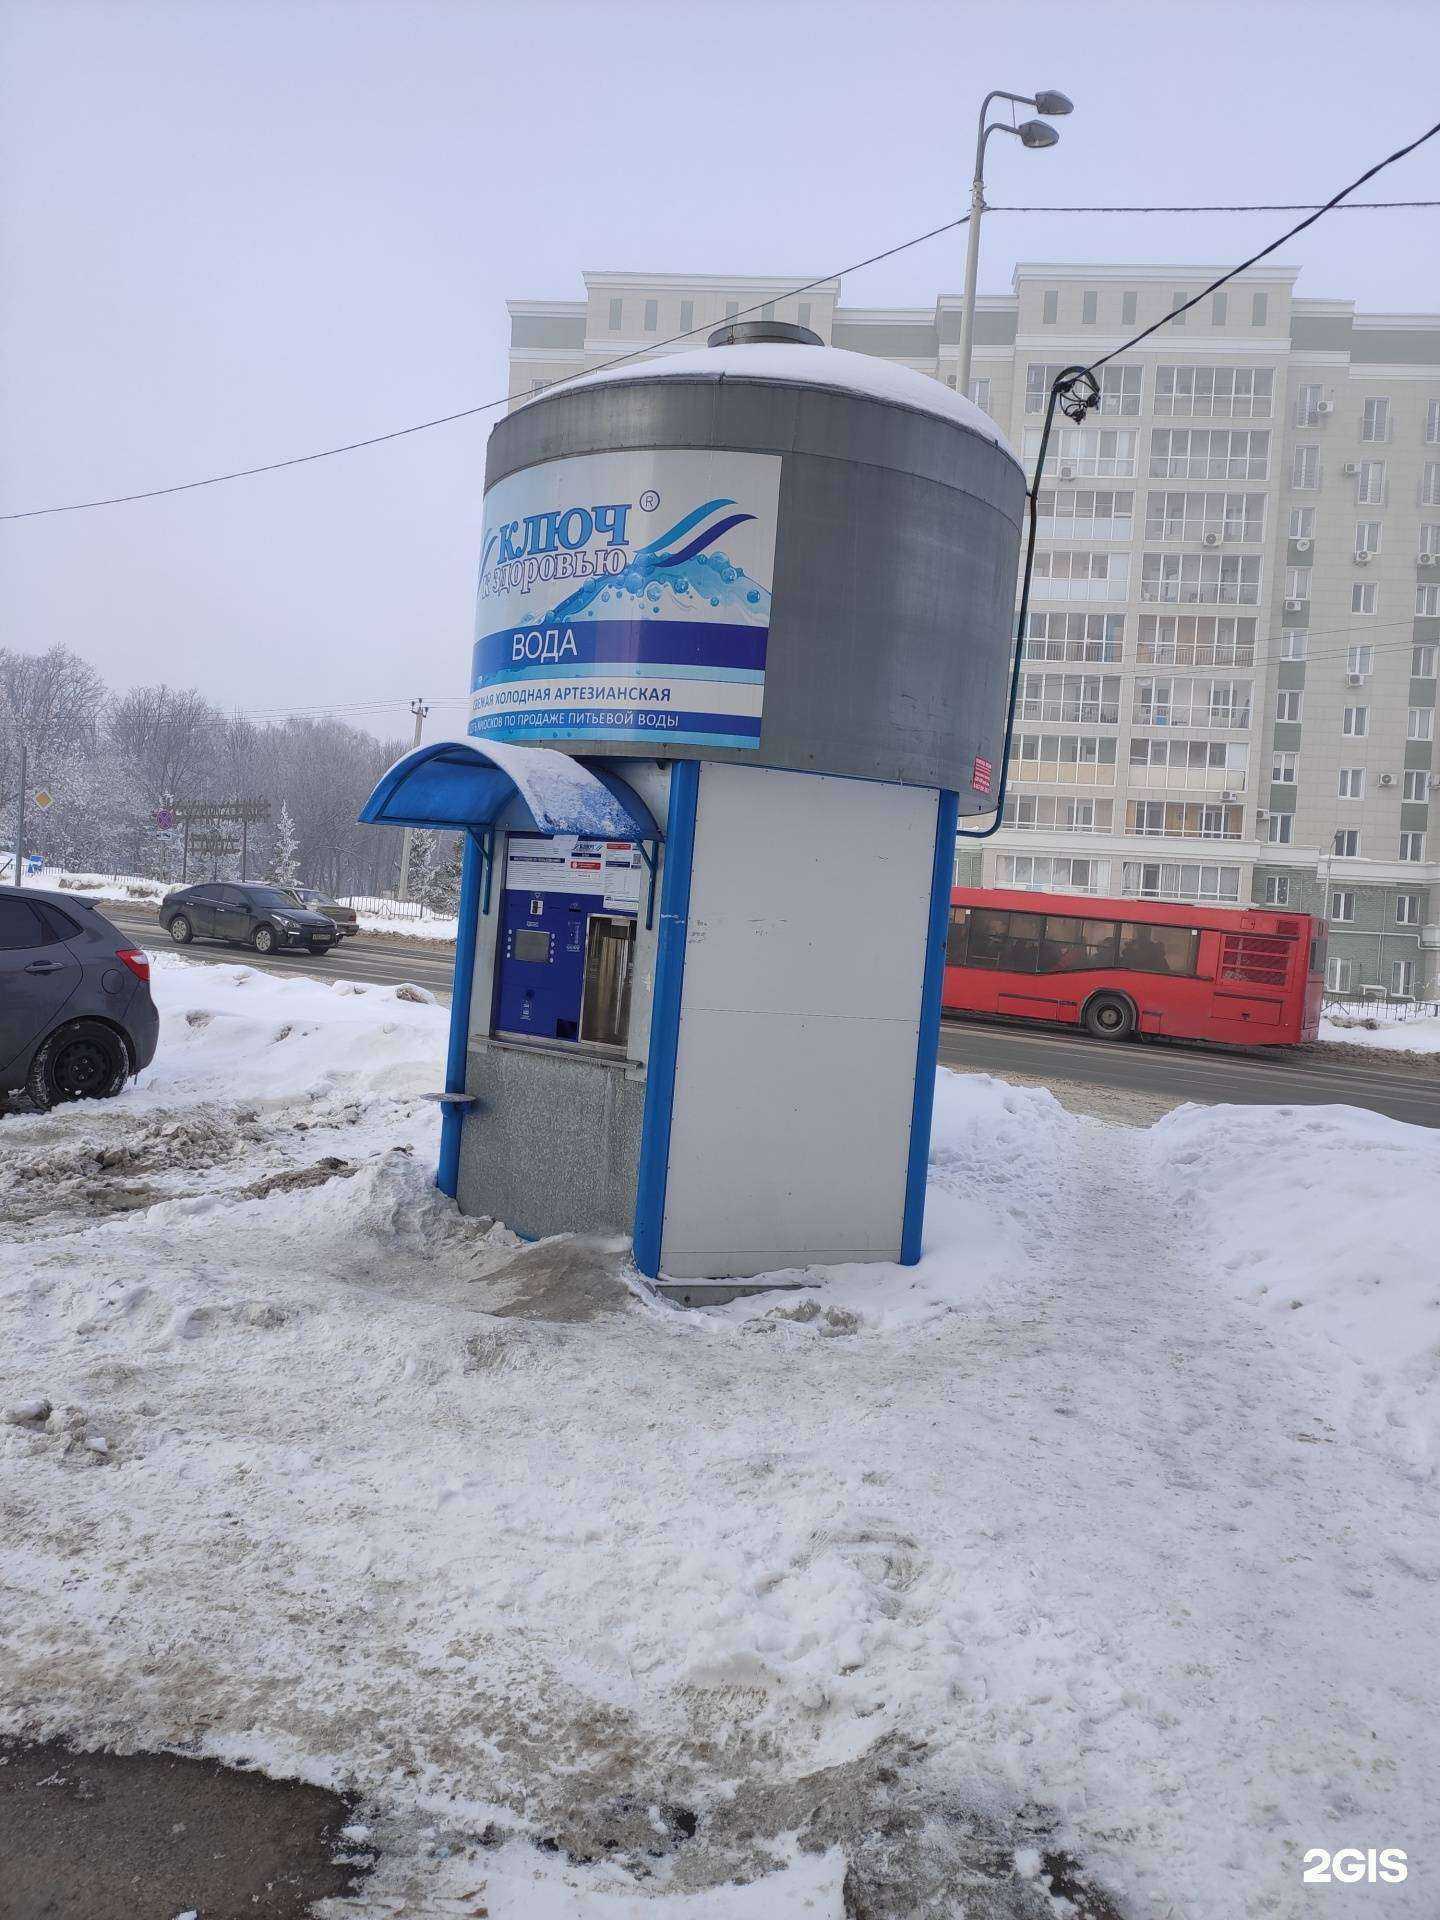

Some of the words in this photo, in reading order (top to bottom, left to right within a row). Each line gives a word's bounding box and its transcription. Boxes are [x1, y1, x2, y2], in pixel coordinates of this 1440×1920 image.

[497, 503, 633, 566] КЛЮЧ
[511, 628, 579, 664] ВОДА
[495, 686, 551, 706] ХОЛОДНАЯ
[554, 685, 671, 703] АРТЕЗИАНСКАЯ
[504, 713, 516, 727] ПО
[517, 711, 565, 728] ПРОДАЖЕ
[567, 709, 634, 725] ПИТЬЕВОЙ
[637, 713, 680, 729] ВОДЫ
